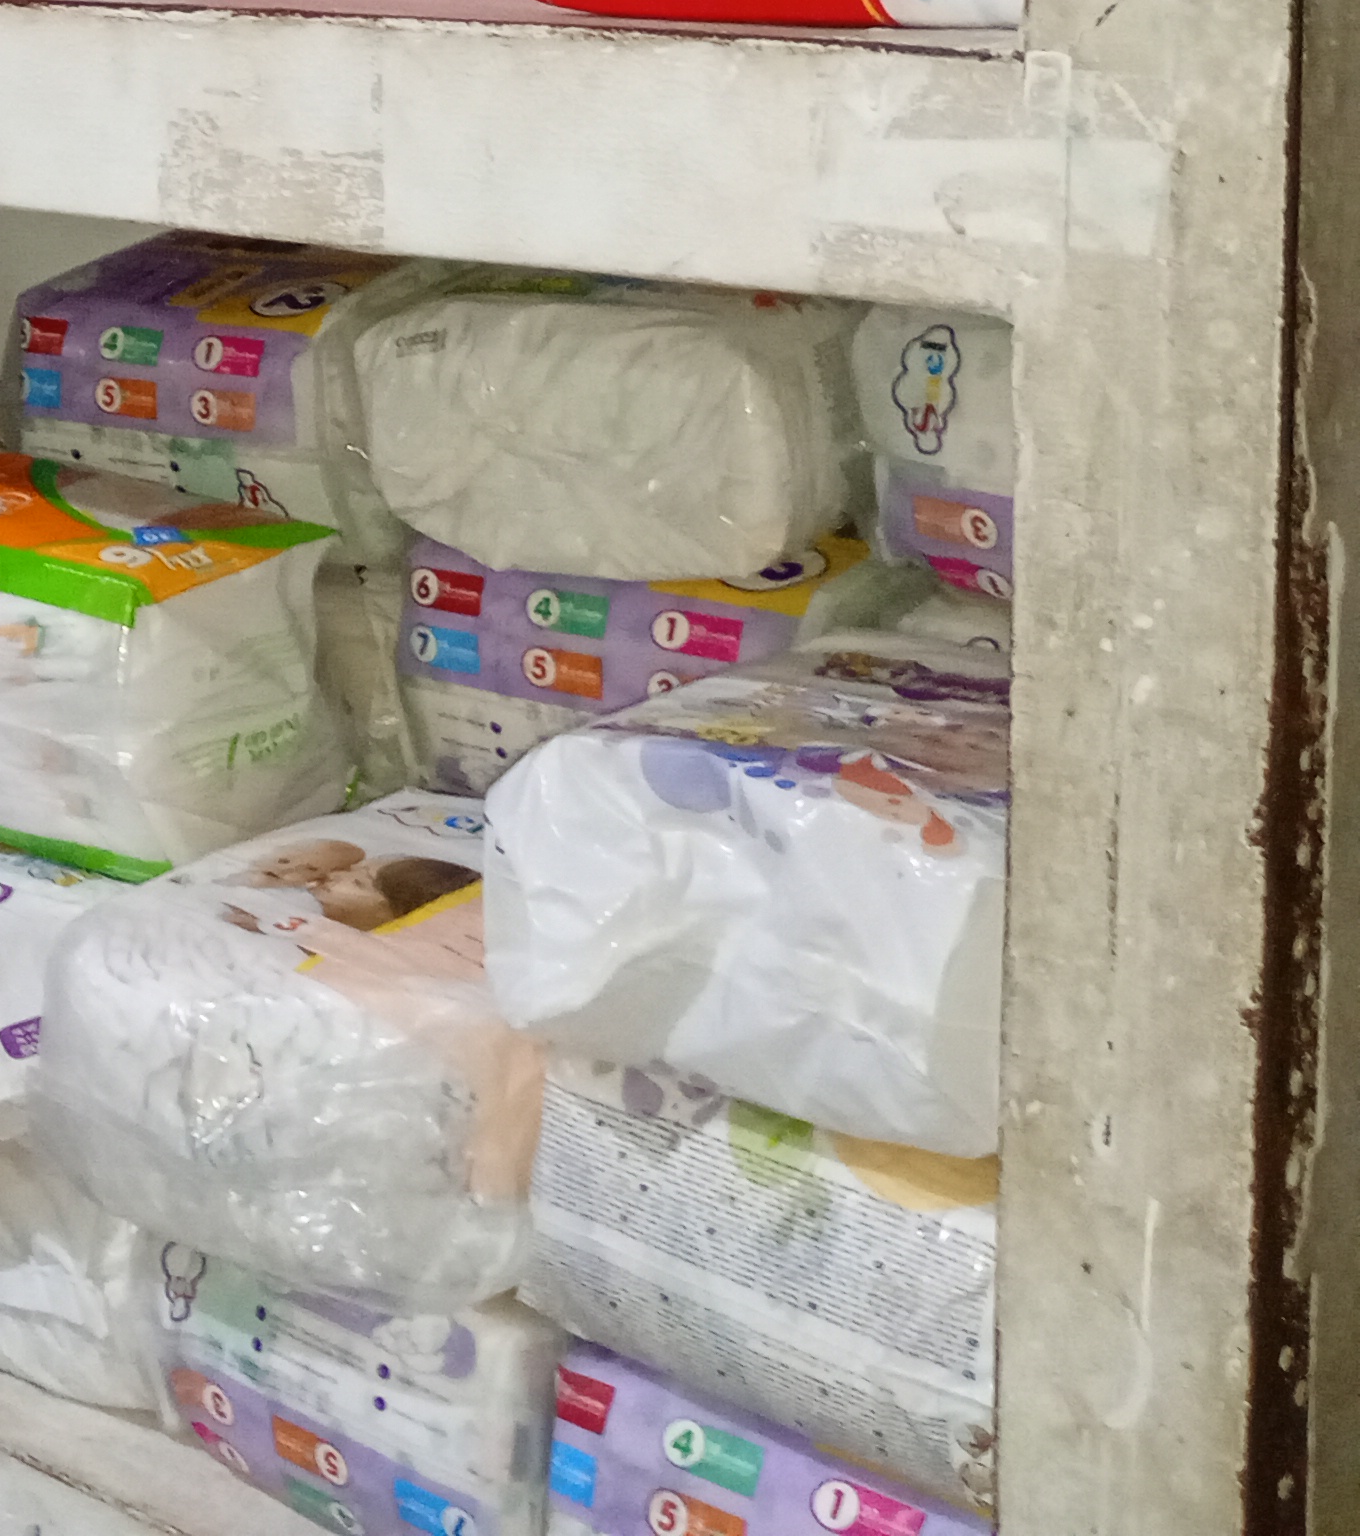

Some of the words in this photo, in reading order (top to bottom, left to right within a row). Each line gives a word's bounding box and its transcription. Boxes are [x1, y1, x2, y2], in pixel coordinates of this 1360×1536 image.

[533, 596, 552, 622] 4
[532, 655, 548, 680] 5
[656, 1499, 677, 1532] 5
